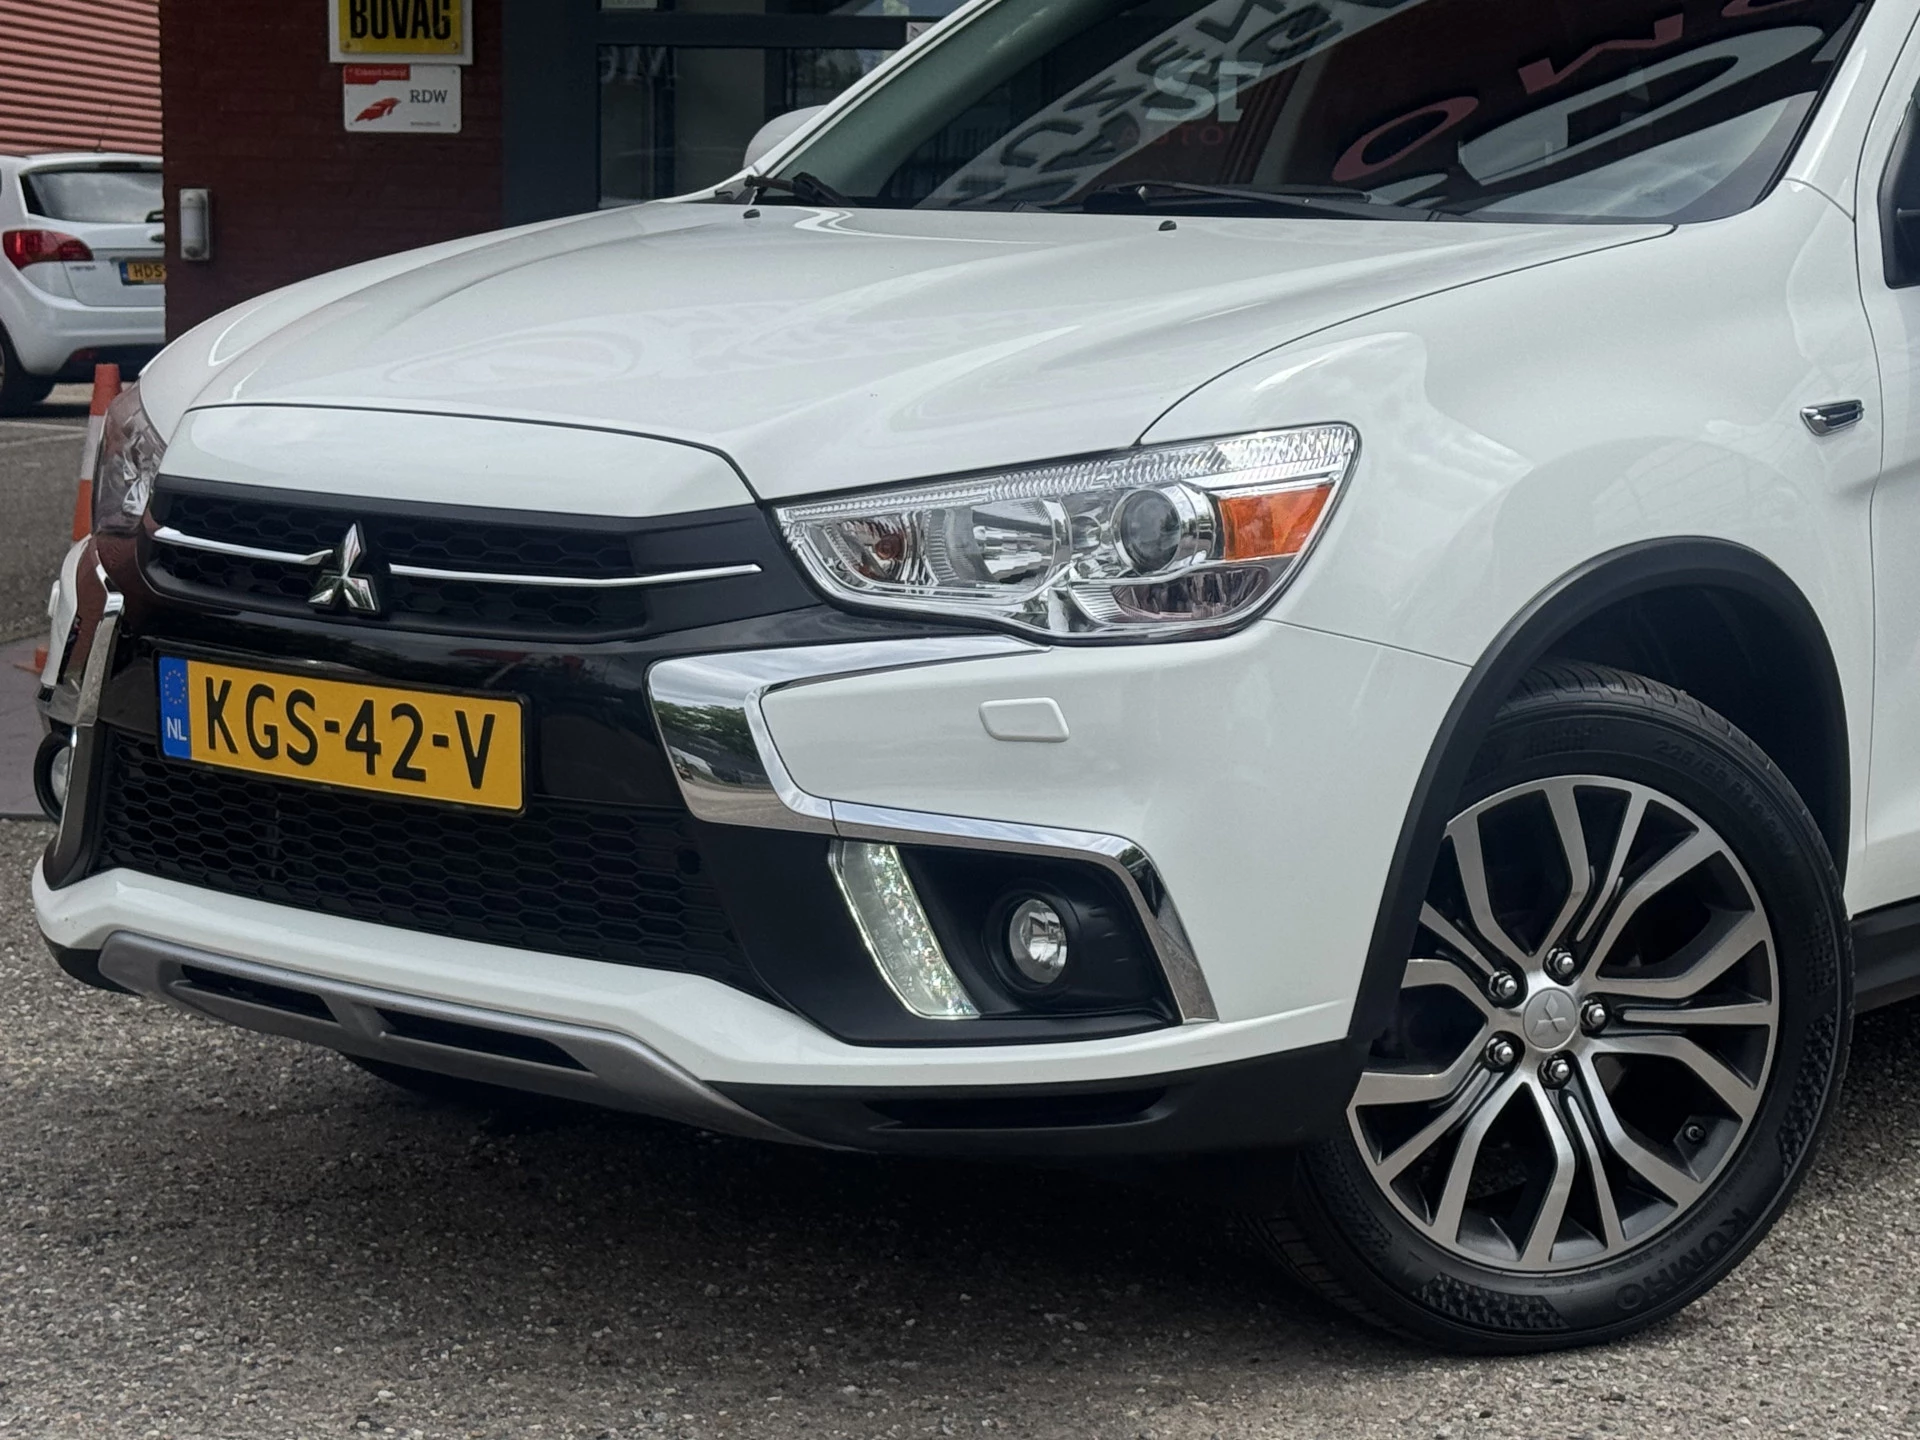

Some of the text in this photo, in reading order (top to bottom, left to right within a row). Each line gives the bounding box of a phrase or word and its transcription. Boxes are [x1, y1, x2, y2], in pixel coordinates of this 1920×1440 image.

[351, 0, 450, 39] BOVAG
[410, 90, 448, 103] RDW
[166, 717, 188, 742] NL
[206, 677, 495, 789] KGS-42-V
[1616, 1207, 1753, 1309] KUMHO
